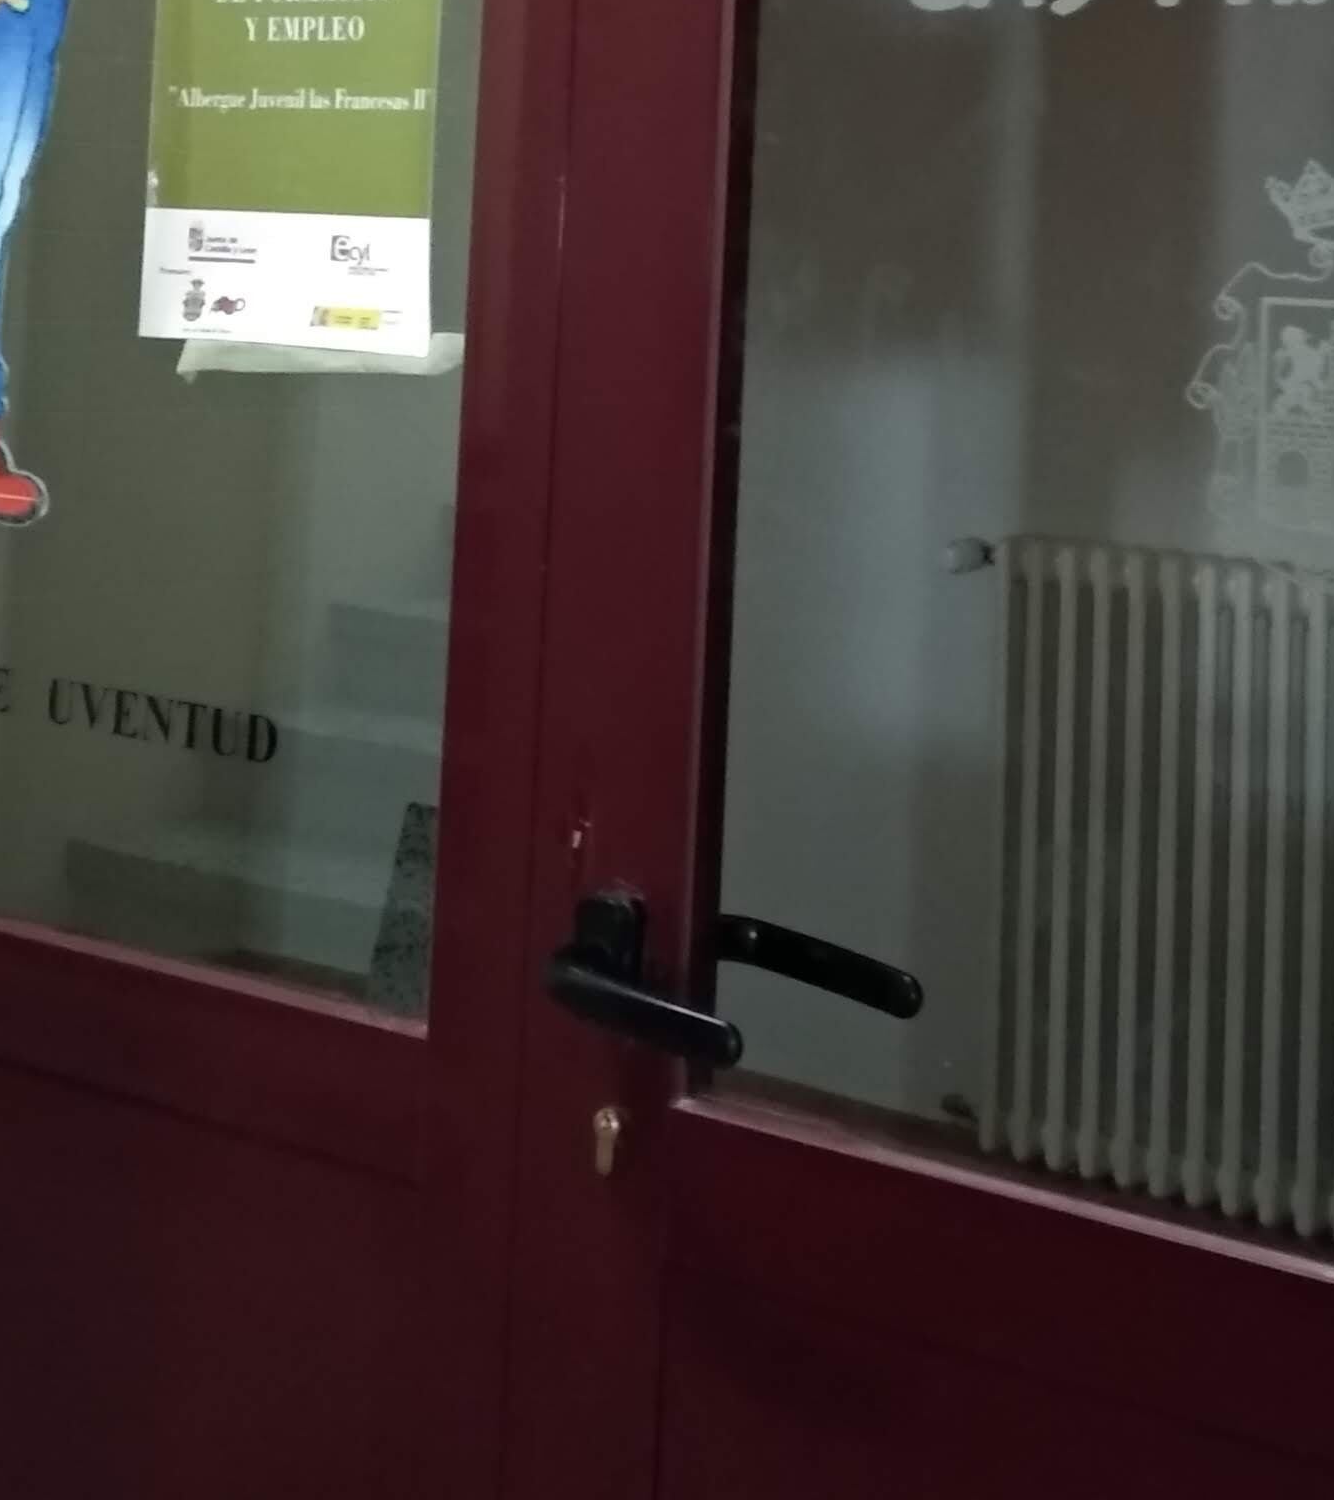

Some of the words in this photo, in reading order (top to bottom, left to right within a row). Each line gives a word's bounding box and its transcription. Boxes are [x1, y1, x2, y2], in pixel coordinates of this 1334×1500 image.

[244, 16, 259, 42] Y
[267, 15, 366, 42] EMPLEO
[249, 87, 306, 111] Juvenil
[335, 87, 411, 111] Francesas
[48, 677, 279, 764] UVENTUD
